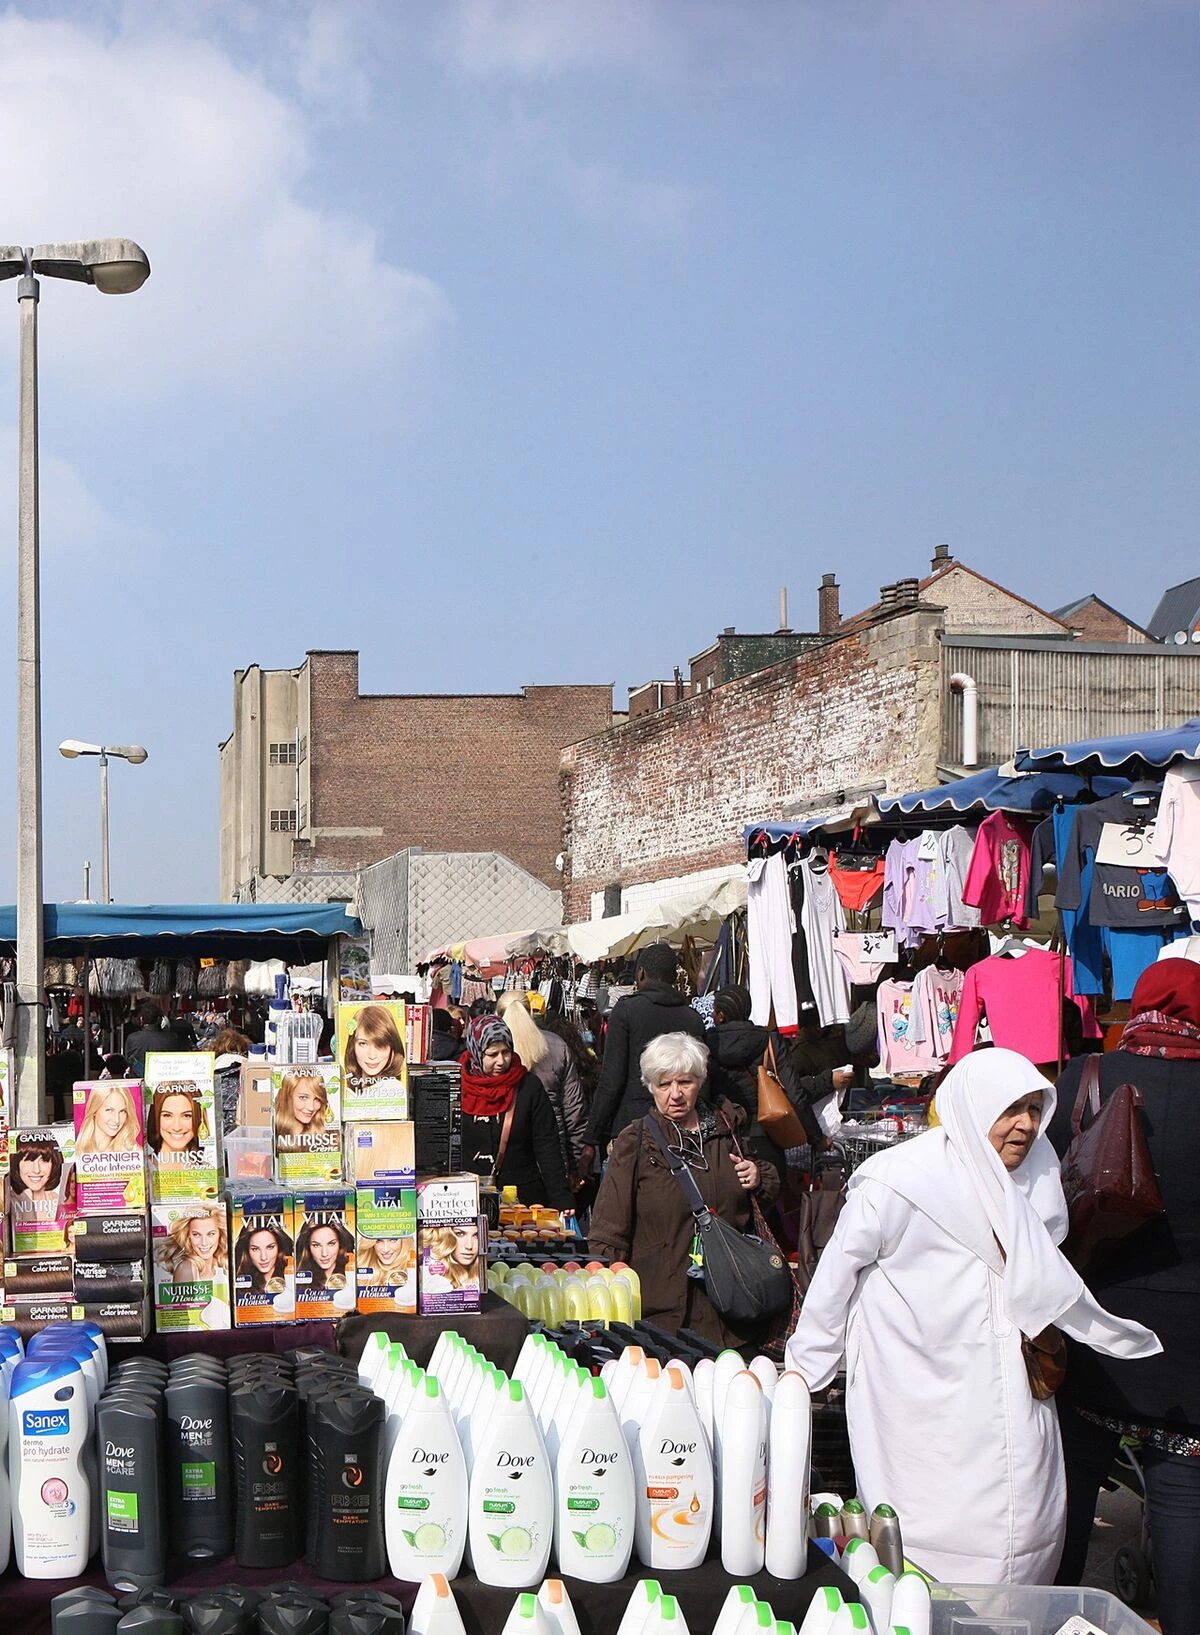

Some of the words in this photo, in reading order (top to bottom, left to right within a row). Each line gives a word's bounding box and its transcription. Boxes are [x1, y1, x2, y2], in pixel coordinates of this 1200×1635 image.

[345, 1086, 405, 1098] Nutrisse
[19, 1133, 57, 1142] GARNI
[278, 1133, 338, 1147] NUTRISSE
[308, 1143, 338, 1153] Crème
[81, 1152, 141, 1163] GARNIER
[151, 1150, 214, 1164] NUTRISSE
[82, 1163, 108, 1172] Color
[109, 1163, 142, 1172] Intense
[14, 1200, 57, 1213] NUTRI
[372, 1199, 401, 1209] VITAL
[431, 1199, 475, 1209] Perfect
[301, 1211, 346, 1225] VITAL
[418, 1208, 468, 1218] Mousse
[102, 1219, 141, 1227] GARNIER
[240, 1214, 285, 1229] VITAL
[75, 1268, 107, 1276] Nutrisse
[162, 1285, 210, 1296] NUTRISSE
[30, 1306, 68, 1314] GARNIER
[25, 1413, 68, 1428] Sanex
[180, 1415, 213, 1430] Dove
[181, 1431, 203, 1440] MEN
[23, 1448, 37, 1457] pro
[38, 1445, 71, 1457] hydrate
[105, 1441, 135, 1458] Dove
[660, 1438, 697, 1454] Dove
[411, 1447, 450, 1463] Dove
[496, 1450, 535, 1467] Dove
[580, 1448, 618, 1464] Dove
[106, 1458, 125, 1468] MEN
[106, 1466, 135, 1476] +CARE
[665, 1473, 694, 1481] pampering
[331, 1494, 370, 1506] AXE
